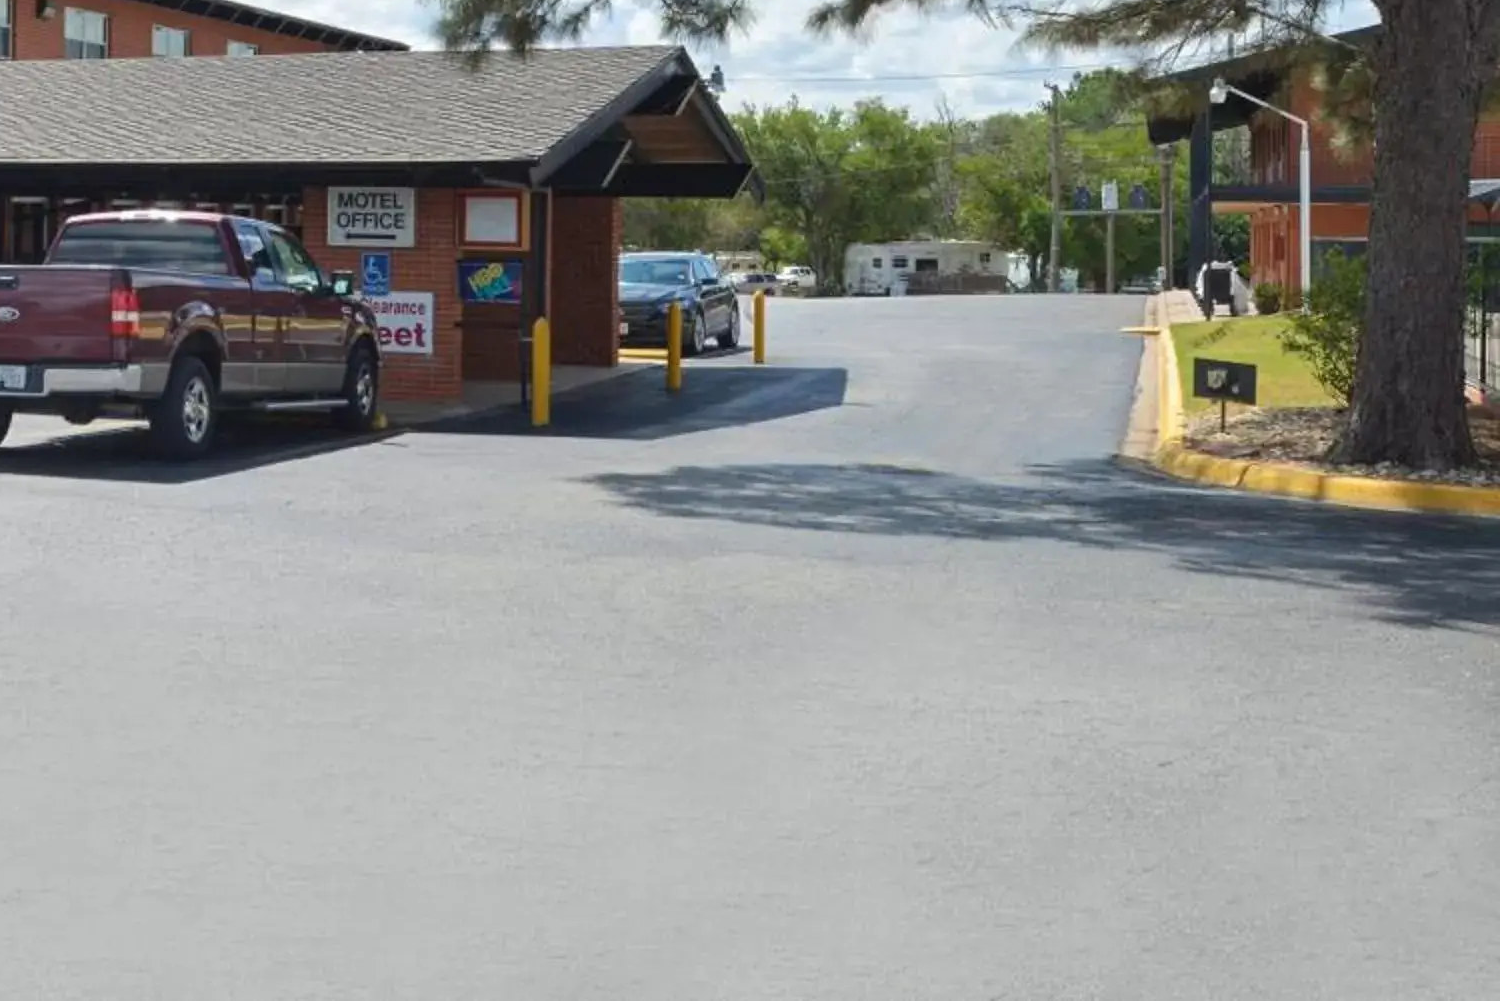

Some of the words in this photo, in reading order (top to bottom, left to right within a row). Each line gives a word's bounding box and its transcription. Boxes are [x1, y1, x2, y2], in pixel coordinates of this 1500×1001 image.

[337, 192, 404, 209] MOTEL
[336, 212, 406, 230] OFFICE
[362, 297, 426, 316] earance
[377, 322, 427, 348] eet
